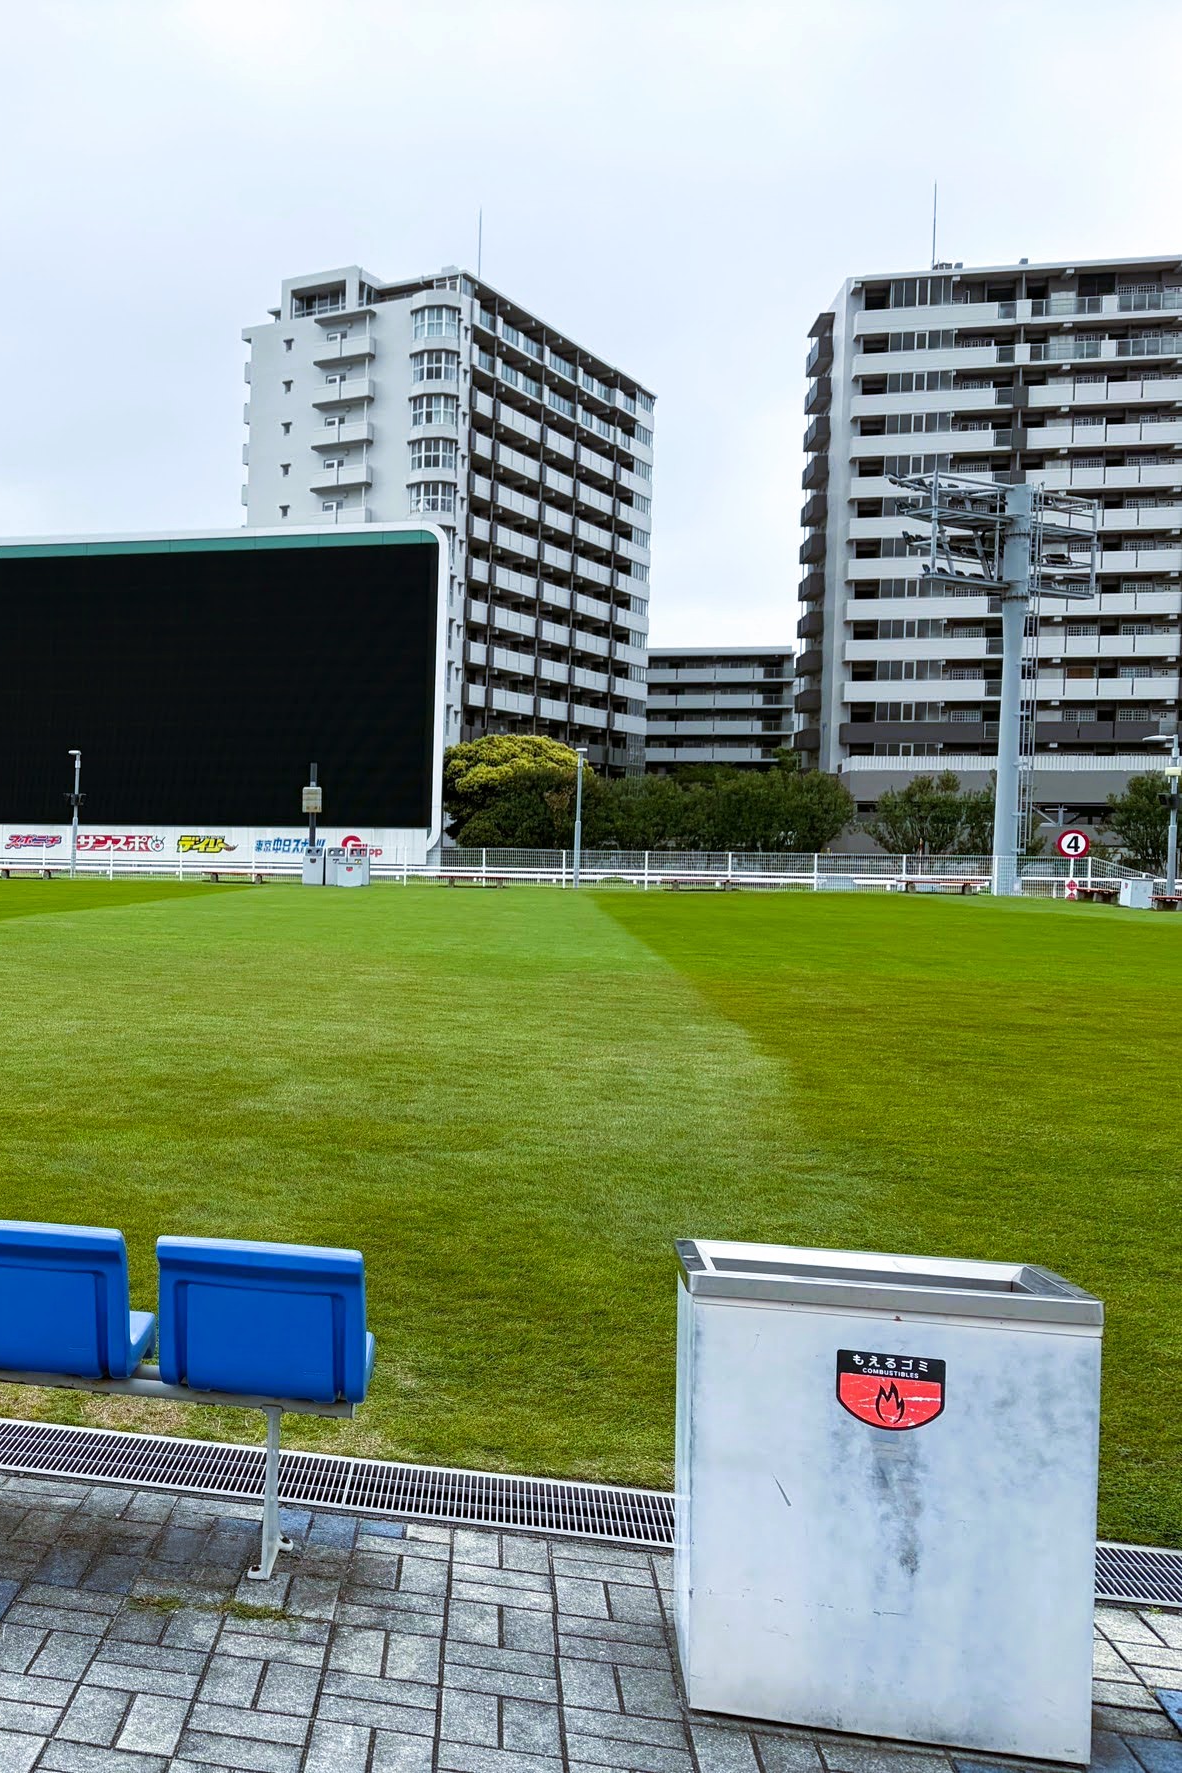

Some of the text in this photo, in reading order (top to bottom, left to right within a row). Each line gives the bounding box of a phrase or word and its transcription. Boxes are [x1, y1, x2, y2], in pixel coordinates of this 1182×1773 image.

[1067, 836, 1080, 852] 4
[852, 1354, 928, 1372] もえるゴミ
[862, 1367, 919, 1379] COMBUSTIBLES
